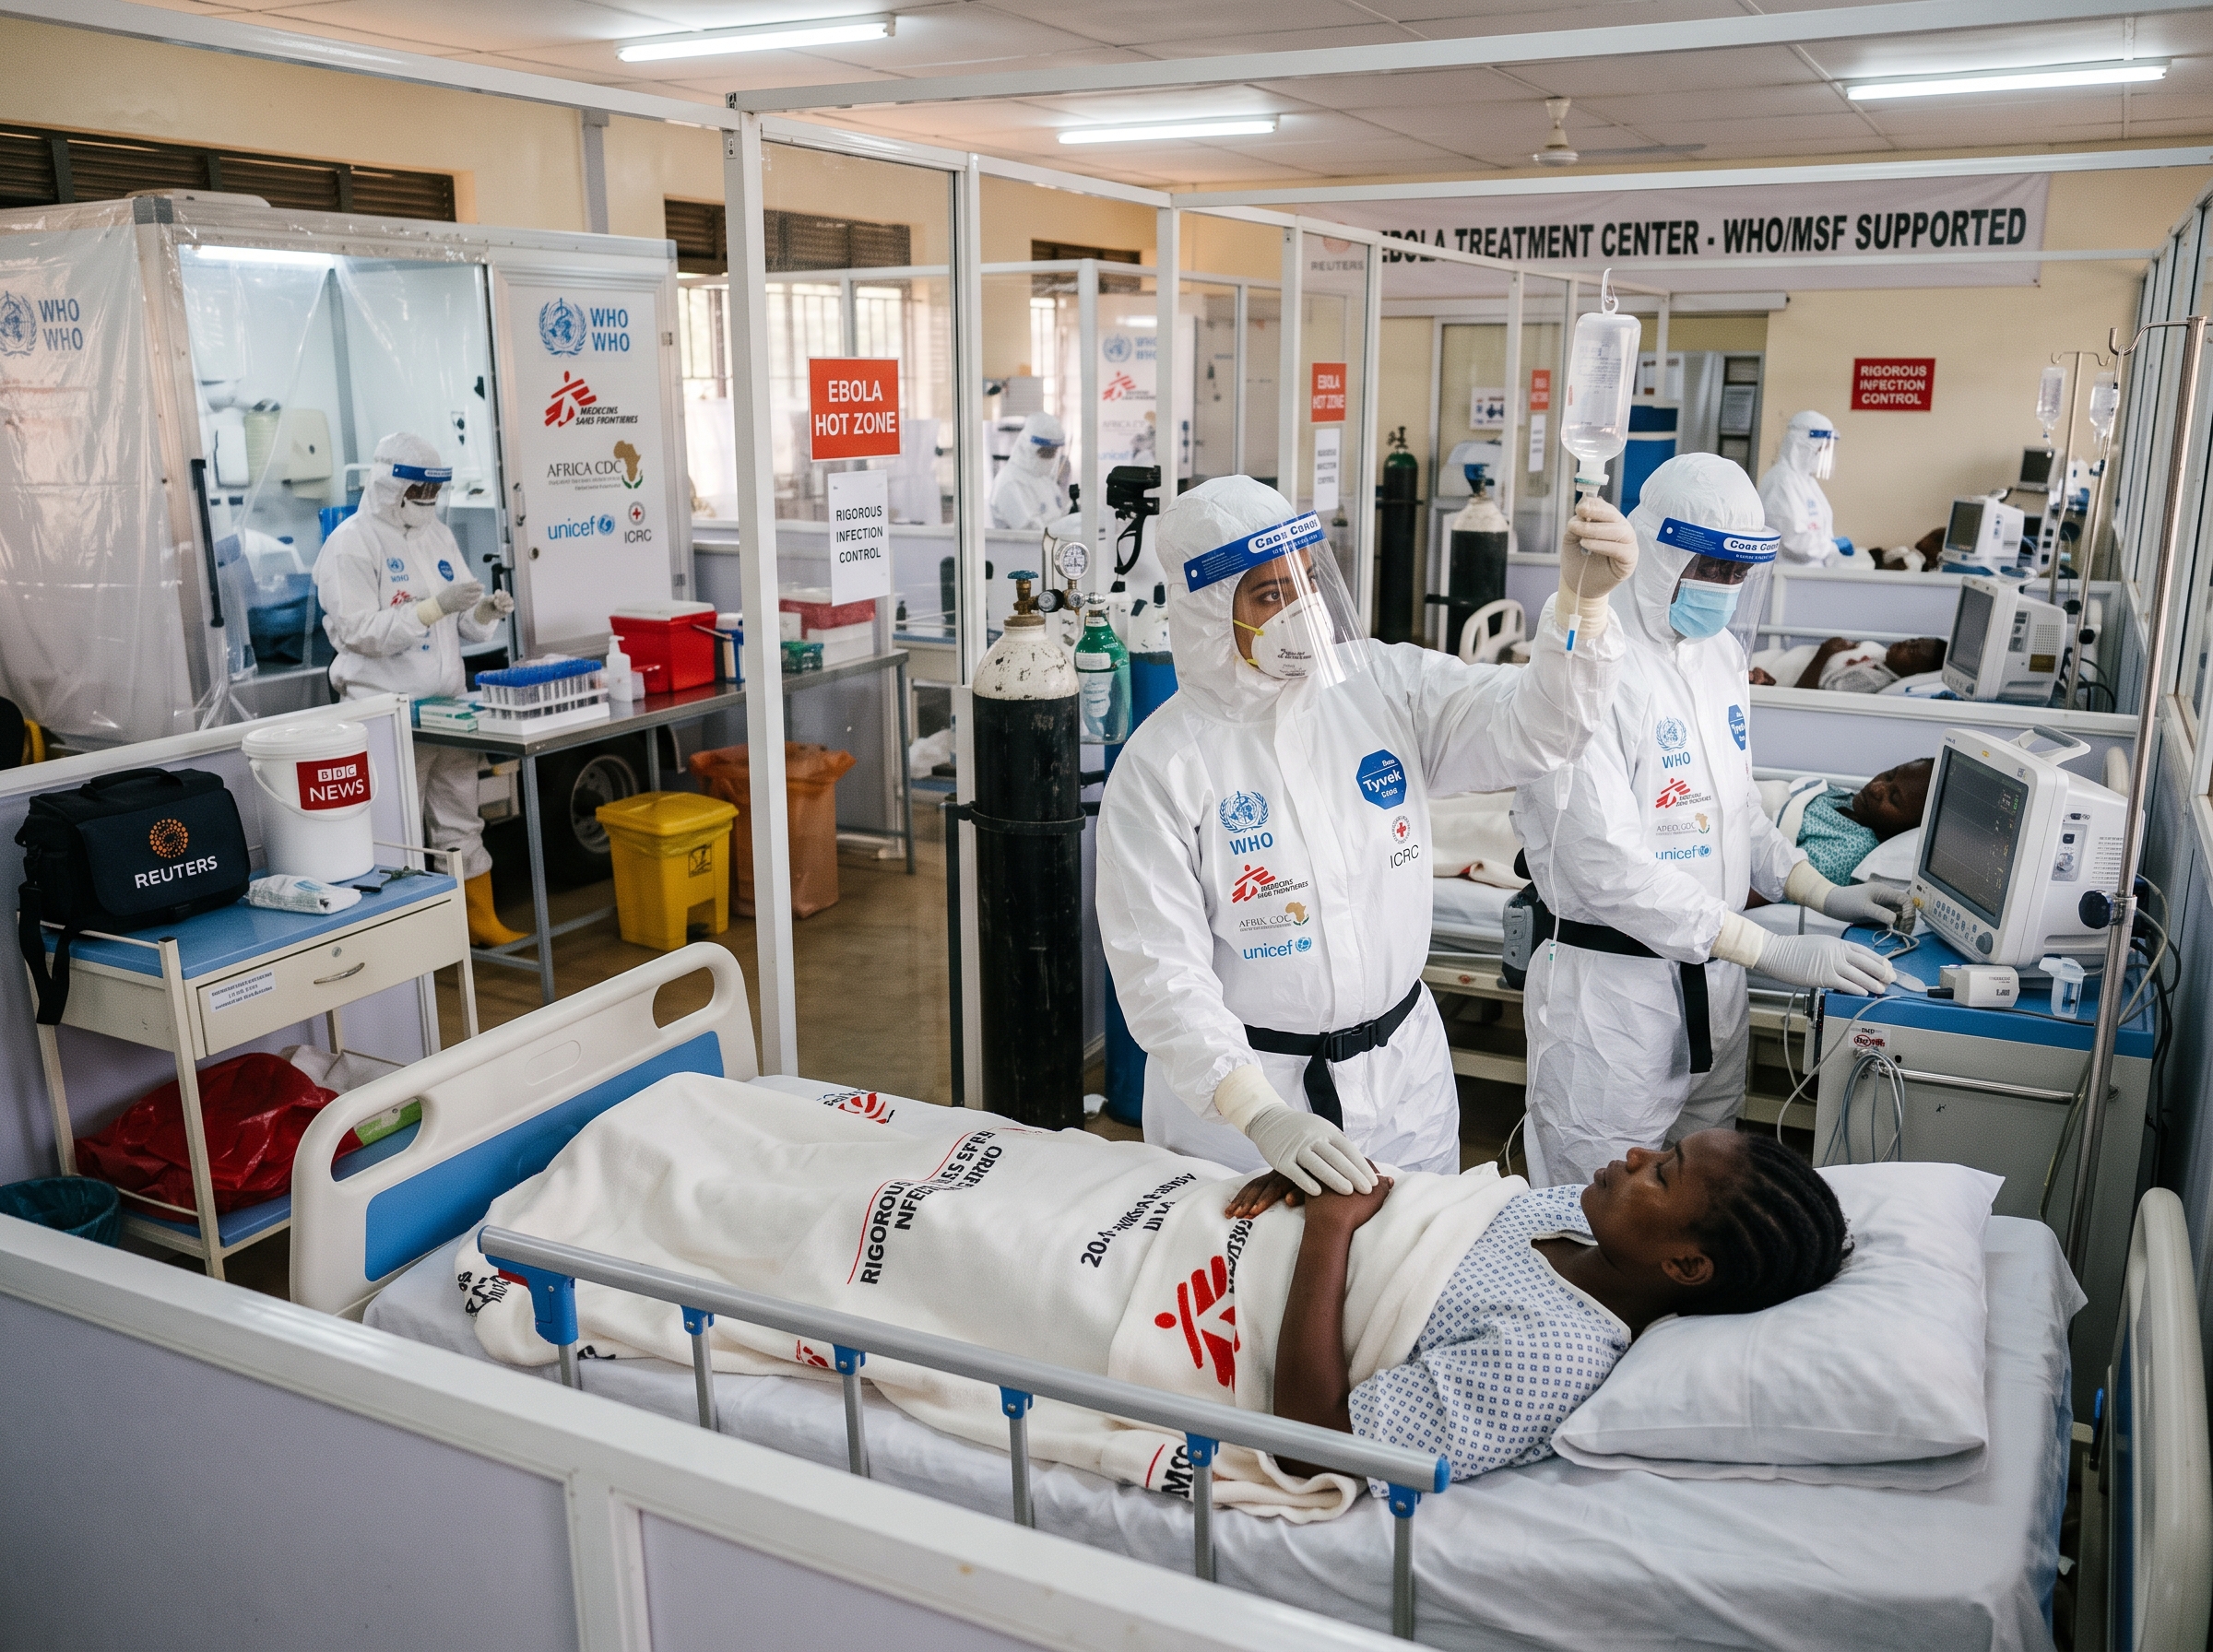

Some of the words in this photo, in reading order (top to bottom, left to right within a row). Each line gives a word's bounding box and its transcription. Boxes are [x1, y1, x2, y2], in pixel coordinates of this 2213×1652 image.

[1455, 224, 1594, 259] TREATMENT
[1601, 220, 1699, 257] CENTER
[1723, 215, 1847, 254] WHO/MSF
[1854, 207, 2027, 251] SUPPORTED
[38, 299, 79, 323] WHO
[590, 308, 629, 328] WHO
[42, 327, 83, 351] WHO
[591, 333, 630, 352] WHO
[1860, 365, 1927, 377] RIGOROUS
[828, 380, 883, 403] EBOLA
[1861, 393, 1922, 405] CONTROL
[815, 413, 849, 436] HOT
[853, 411, 896, 434] ZONE
[547, 462, 592, 478] AFRICA
[595, 460, 622, 475] CDC
[835, 505, 882, 522] RIGOROUS
[548, 515, 595, 540] unicef
[624, 528, 652, 544] ICRC
[835, 526, 883, 543] INFECTION
[839, 548, 882, 563] CONTROL
[1662, 751, 1691, 769] WHO
[310, 778, 364, 802] NEWS
[1363, 770, 1402, 793] Tyvek
[1229, 832, 1273, 856] WHO
[1655, 844, 1698, 860] unicef
[1390, 844, 1419, 868] ICRC
[134, 856, 218, 889] REUTERS
[1243, 940, 1293, 960] unicef
